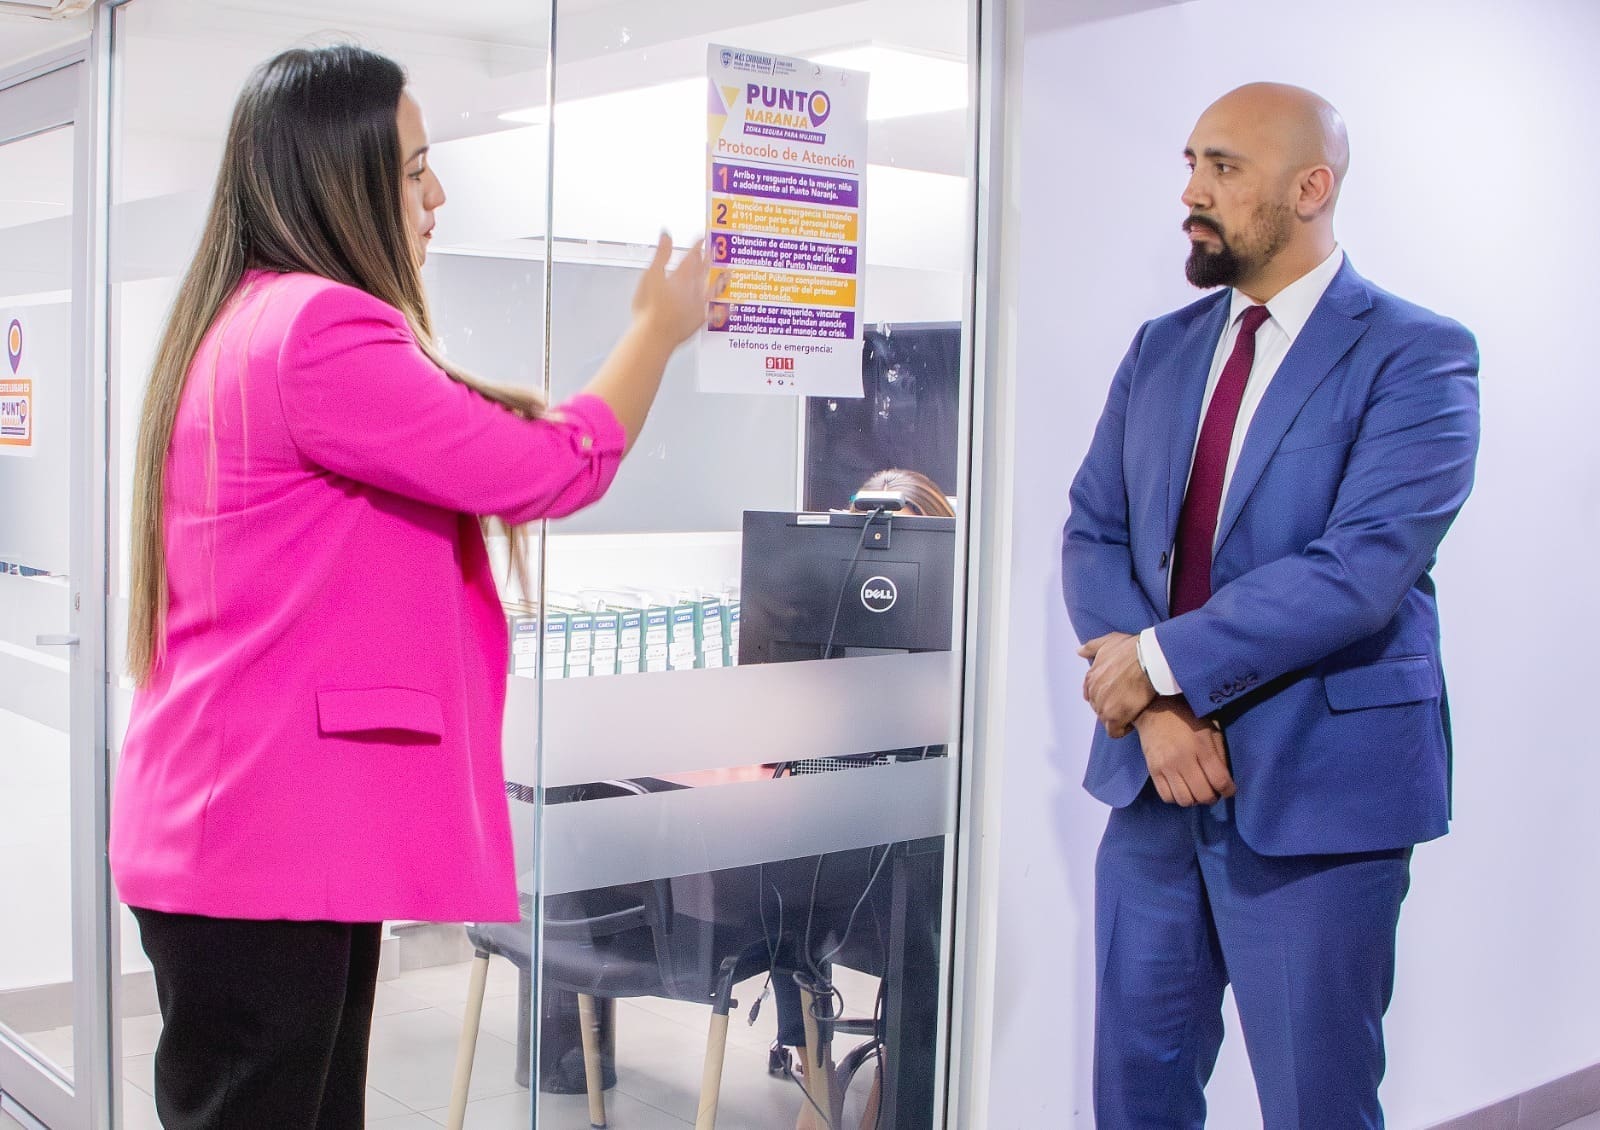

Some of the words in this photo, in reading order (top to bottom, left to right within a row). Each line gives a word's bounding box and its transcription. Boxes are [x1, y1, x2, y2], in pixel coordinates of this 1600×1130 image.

[745, 109, 808, 128] NARANJA
[746, 126, 761, 134] ZONA
[762, 128, 783, 137] SEGURA
[784, 130, 798, 139] PARA
[800, 133, 823, 142] MUJERES
[718, 138, 778, 159] Protocolo
[782, 146, 798, 161] de
[802, 150, 854, 168] Atención
[718, 166, 728, 190] 1
[733, 170, 755, 180] Arribo
[756, 174, 761, 182] y
[763, 174, 797, 185] resguardo
[798, 176, 807, 186] de
[809, 178, 815, 187] la
[816, 180, 837, 190] mujer,
[838, 182, 852, 191] niña
[740, 180, 780, 192] adolescente
[782, 185, 788, 194] al
[790, 186, 810, 196] Punto
[811, 188, 838, 200] Naranja.
[716, 204, 727, 224] 2
[732, 200, 762, 212] Atención
[764, 204, 774, 213] de
[776, 205, 782, 214] la
[732, 210, 738, 219] al
[740, 211, 752, 222] 911
[755, 215, 766, 224] por
[789, 216, 800, 225] del
[716, 236, 727, 260] 3
[731, 236, 767, 247] Obtención
[768, 239, 778, 248] de
[779, 240, 798, 250] datos
[800, 241, 808, 251] de
[810, 243, 816, 252] la
[839, 246, 853, 255] niña
[738, 246, 778, 258] adolescente
[780, 252, 792, 260] por
[794, 252, 811, 262] parte
[812, 254, 823, 262] del
[825, 252, 840, 264] líder
[730, 257, 772, 268] responsable
[773, 259, 784, 268] del
[786, 260, 806, 270] Punto
[806, 262, 834, 273] Naranja.
[768, 272, 794, 283] Pública
[780, 284, 799, 296] partir
[802, 286, 813, 295] del
[814, 286, 836, 297] primer
[730, 304, 739, 312] En
[758, 304, 767, 314] de
[780, 308, 815, 318] requerido,
[816, 308, 842, 319] vincular
[744, 314, 777, 324] instancias
[778, 317, 791, 326] que
[792, 316, 818, 326] brindan
[819, 319, 846, 329] atención
[728, 322, 767, 334] psicológica
[769, 326, 784, 335] para
[785, 325, 792, 334] el
[792, 328, 817, 337] manejo
[818, 328, 827, 336] de
[828, 328, 847, 338] crisis.
[729, 339, 769, 350] Teléfonos
[771, 341, 782, 351] de
[784, 344, 833, 354] emergencia:
[766, 357, 794, 370] 911
[865, 589, 893, 600] DELL
